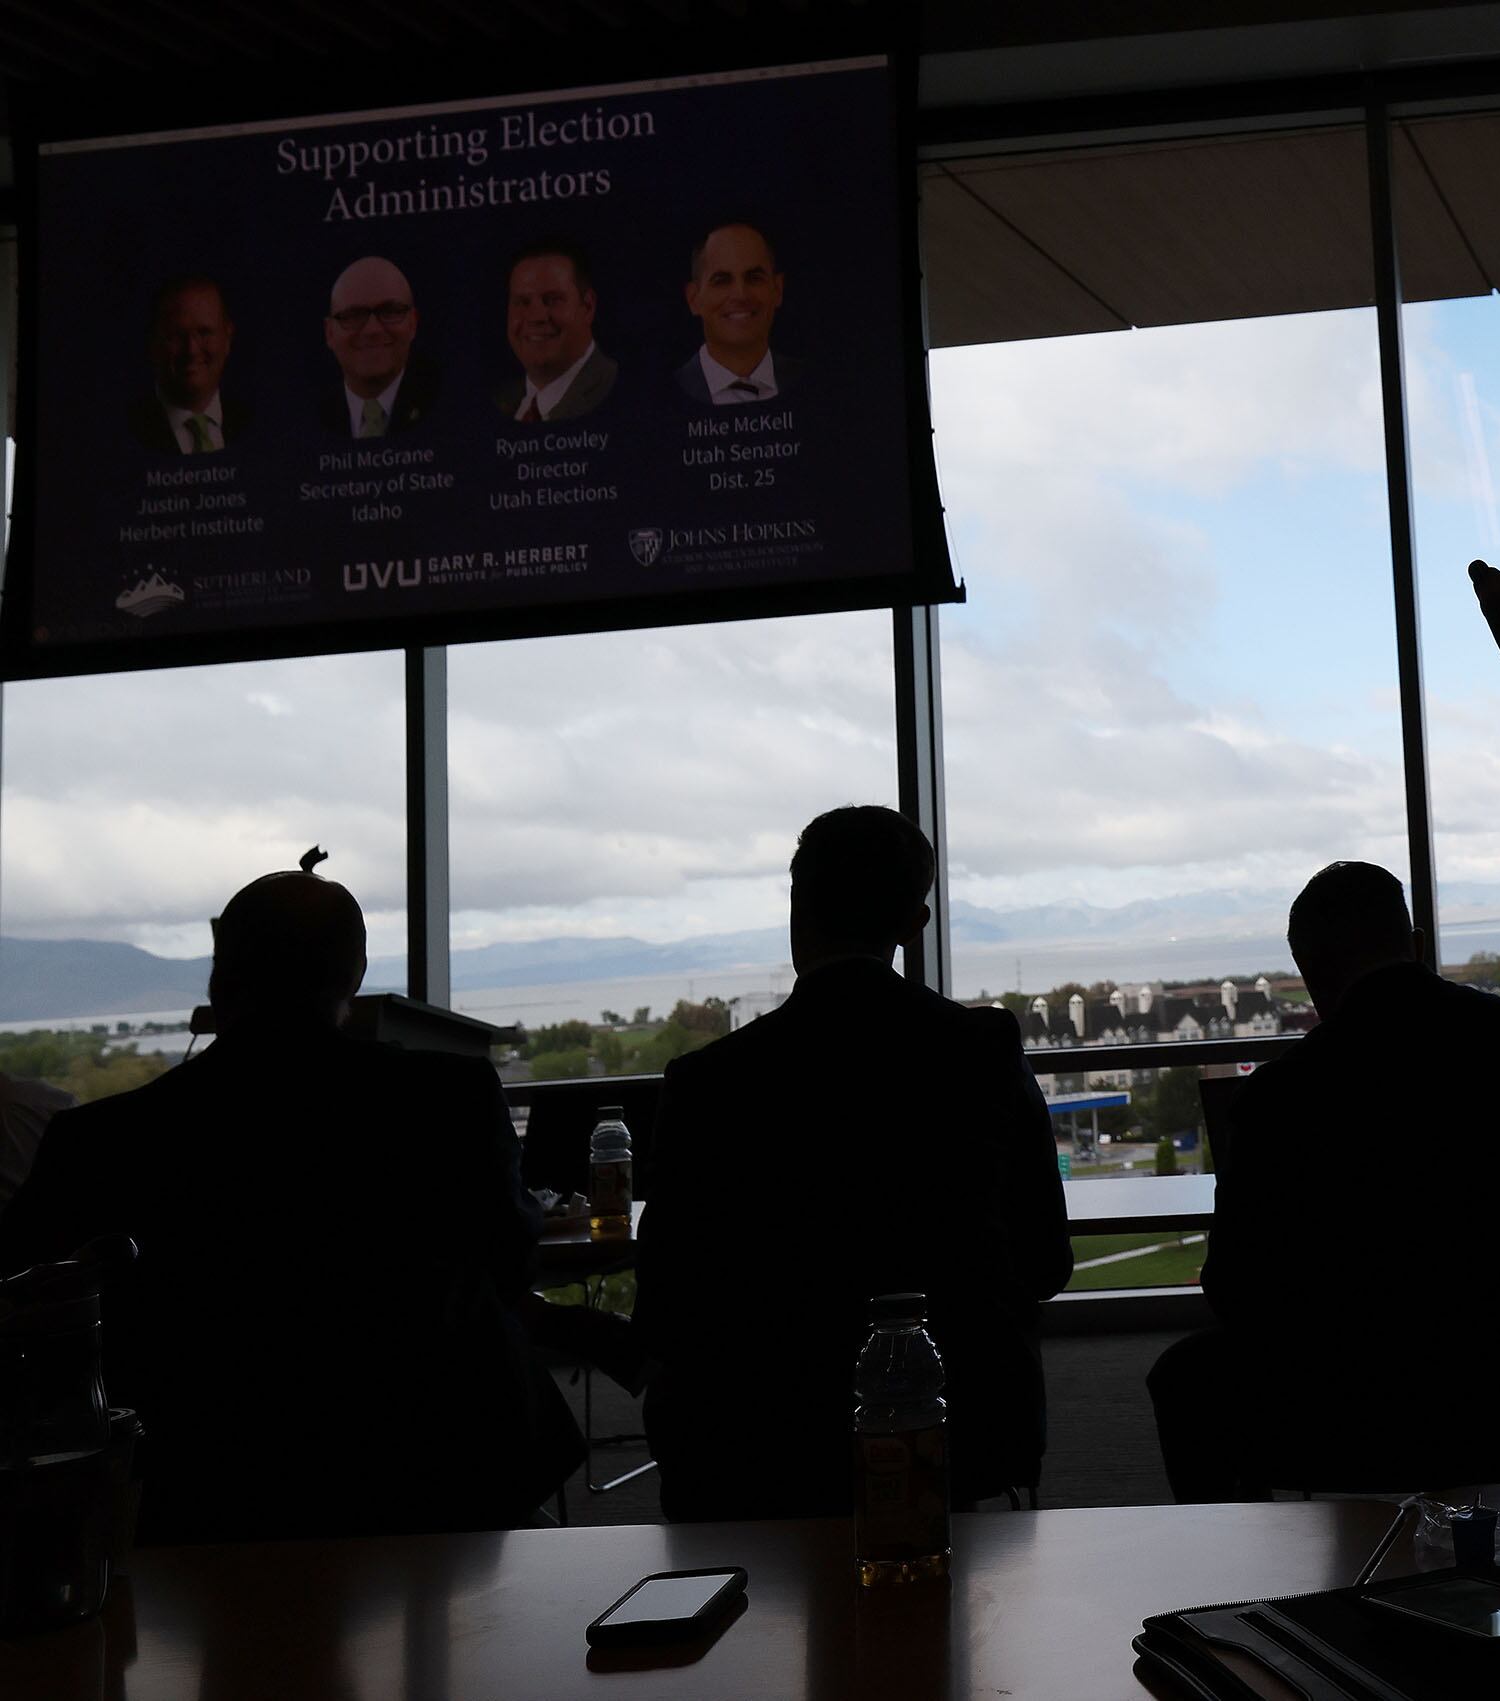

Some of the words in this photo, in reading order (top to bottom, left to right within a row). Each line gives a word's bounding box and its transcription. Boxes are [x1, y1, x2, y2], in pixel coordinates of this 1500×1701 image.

[277, 123, 489, 181] Supporting
[499, 106, 656, 151] Election
[323, 167, 611, 222] Administrators
[688, 418, 730, 438] Mike
[735, 412, 792, 432] McKell
[495, 439, 540, 459] Ryan
[543, 431, 609, 452] Cowley
[683, 446, 724, 465] Utah
[730, 443, 800, 461] Senator
[320, 453, 352, 471] Phil
[357, 449, 434, 467] McGrane
[518, 462, 588, 480] Director
[147, 467, 236, 486] Moderator
[299, 480, 383, 502] Secretary
[387, 473, 404, 492] of
[410, 473, 454, 490] State
[710, 472, 748, 490] Dist.
[754, 468, 774, 486] 25
[138, 495, 190, 515] Justin
[195, 493, 246, 509] Jones
[490, 490, 531, 510] Utah
[537, 485, 617, 505] Elections
[353, 503, 402, 522] Idaho
[119, 522, 187, 544] Herbert
[192, 517, 264, 536] Institute
[666, 527, 727, 553] JOHNS
[732, 519, 816, 544] HOPKINS
[428, 553, 476, 573] GARY
[482, 552, 499, 567] R.
[504, 543, 589, 566] HERBERT
[193, 568, 312, 590] SUTHERLAND
[344, 559, 421, 591] UVU
[428, 571, 487, 585] INSTITUTE
[505, 565, 546, 578] PUBLIC
[549, 561, 589, 574] POLICY
